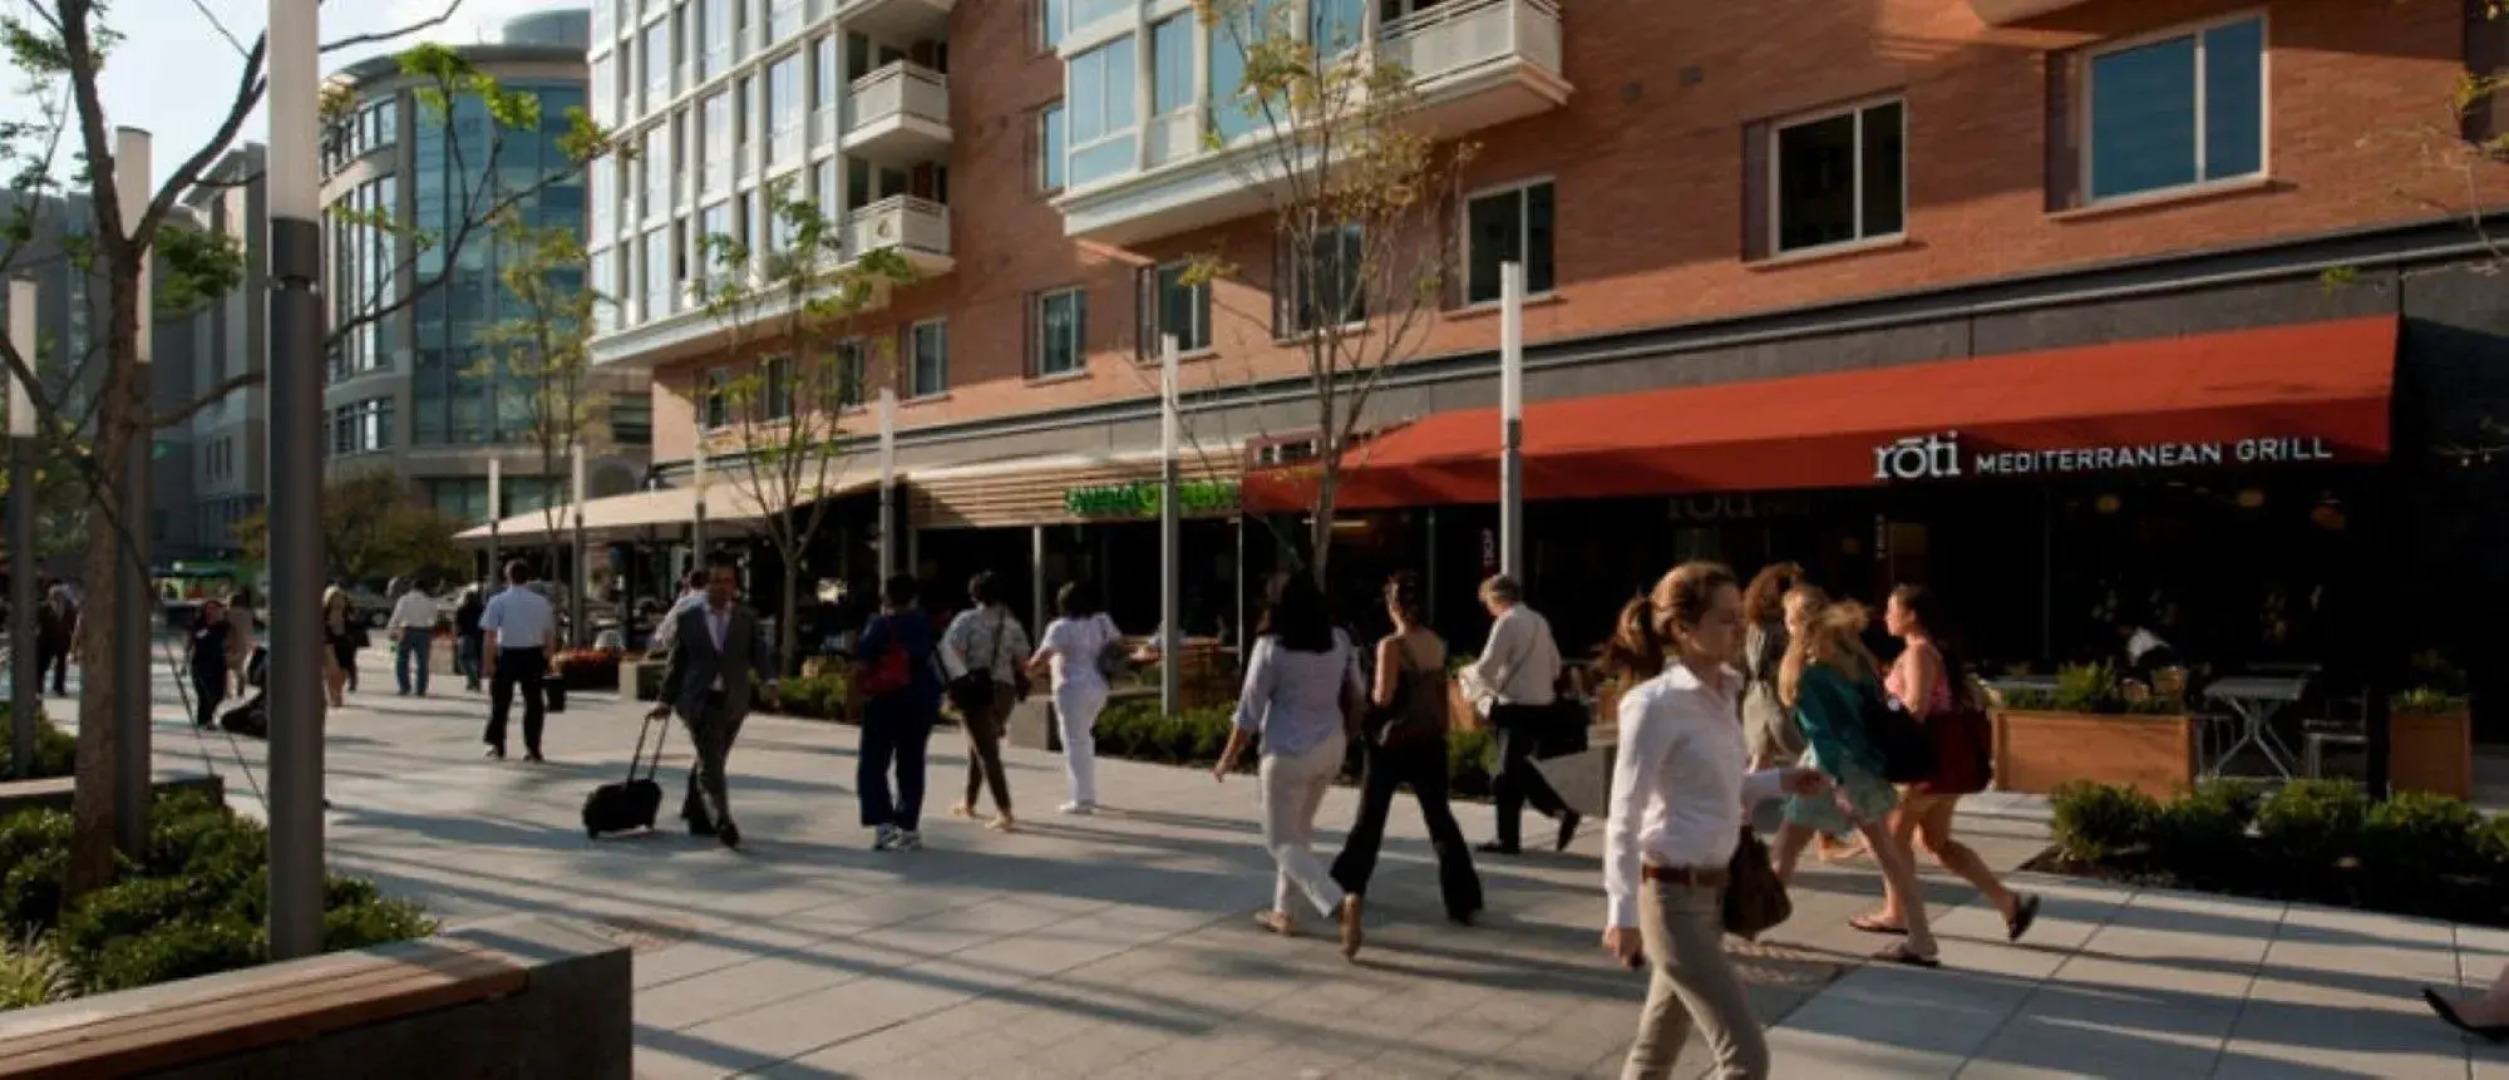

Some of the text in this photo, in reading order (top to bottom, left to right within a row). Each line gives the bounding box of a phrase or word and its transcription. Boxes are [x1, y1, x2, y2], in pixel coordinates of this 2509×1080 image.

[1873, 429, 2333, 479] rōti MEDITERRANEAN GRILL
